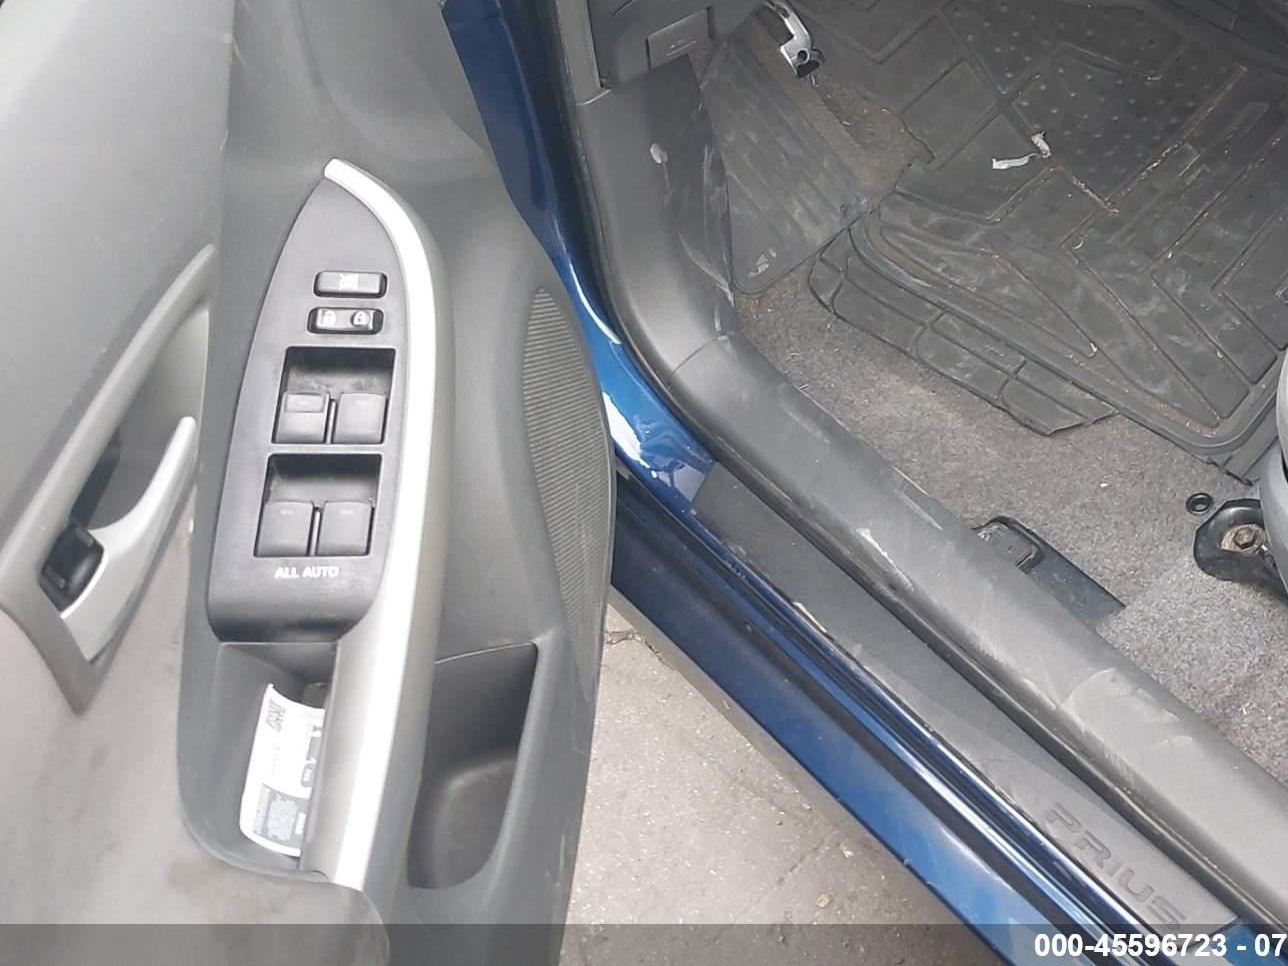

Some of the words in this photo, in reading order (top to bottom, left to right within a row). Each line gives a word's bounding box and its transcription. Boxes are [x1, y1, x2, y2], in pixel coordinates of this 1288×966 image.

[274, 566, 300, 579] ALL
[302, 565, 340, 579] AUTO
[1048, 802, 1187, 932] PRIUS
